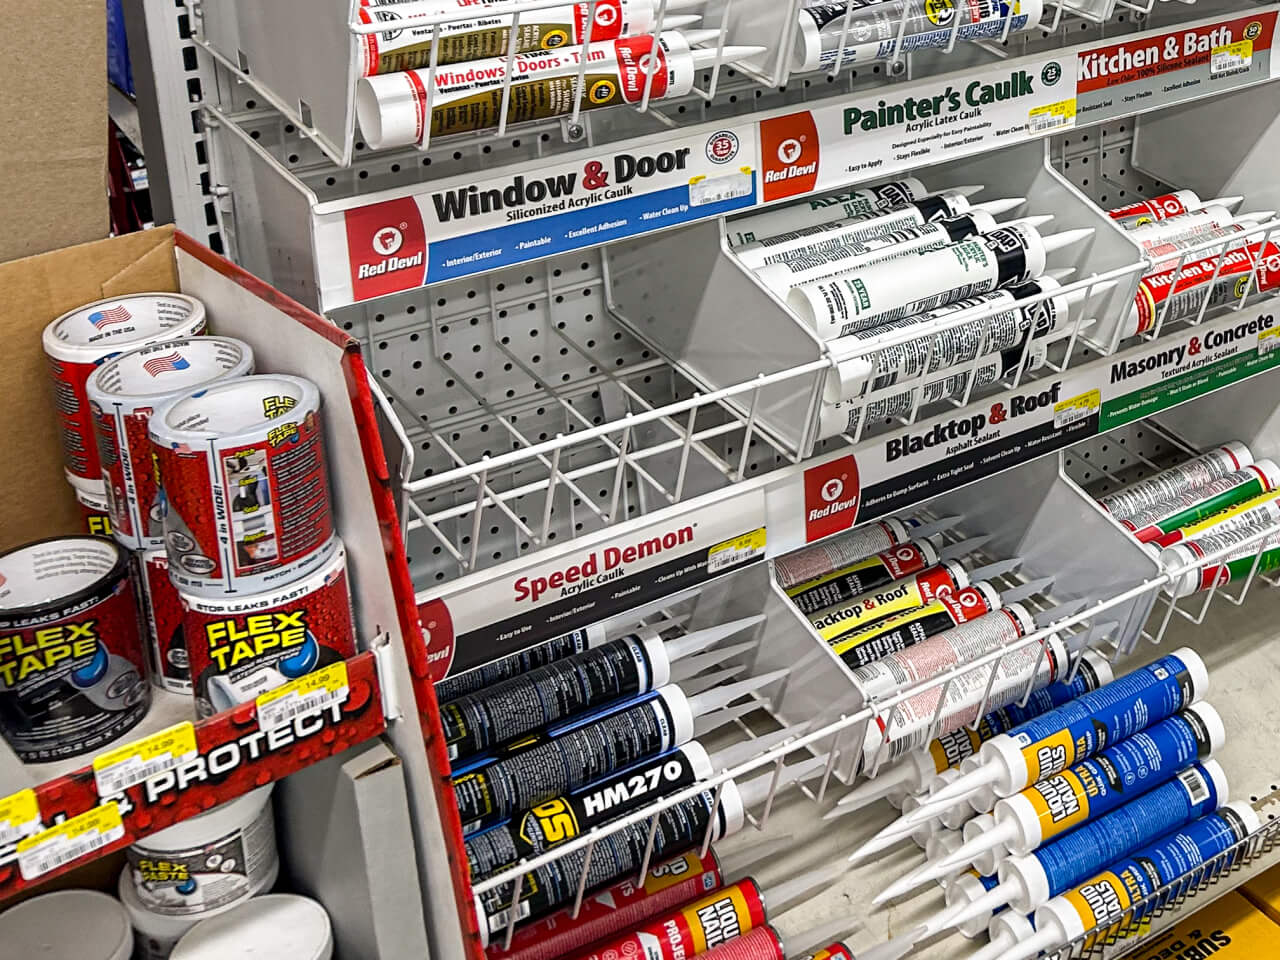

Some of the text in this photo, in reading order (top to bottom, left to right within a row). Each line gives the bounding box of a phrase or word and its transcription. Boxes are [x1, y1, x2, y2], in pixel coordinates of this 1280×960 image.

[434, 55, 561, 88] Windows Doors
[1076, 27, 1233, 81] Kitchen & Bath
[843, 70, 1034, 135] Painter's Caulk
[906, 108, 982, 134] Acrylic Latex Caulk
[432, 148, 690, 222] Window & Door
[765, 162, 816, 183] Red Devil
[506, 185, 633, 222] Siliconized Acrylic Caulk
[359, 252, 422, 278] Red Devil
[1110, 314, 1274, 384] Masonry & Concrete
[1161, 345, 1238, 380] Textured Acrylic Sealant
[885, 382, 1061, 463] Blacktop & Roof
[946, 429, 1001, 457] Asphalt Sealant
[809, 498, 856, 522] Red Devil
[514, 525, 694, 603] Speed Demon
[560, 567, 625, 598] Acrylic Caulk
[196, 586, 309, 614] STOP LEAKS FAST!
[206, 611, 305, 648] FLEX
[211, 628, 308, 671] TAPE
[147, 706, 347, 802] PROTECT
[582, 760, 683, 817] HM270
[1050, 775, 1079, 816] NAILS
[1075, 765, 1098, 797] ULTRA
[1035, 780, 1064, 824] LIQUID
